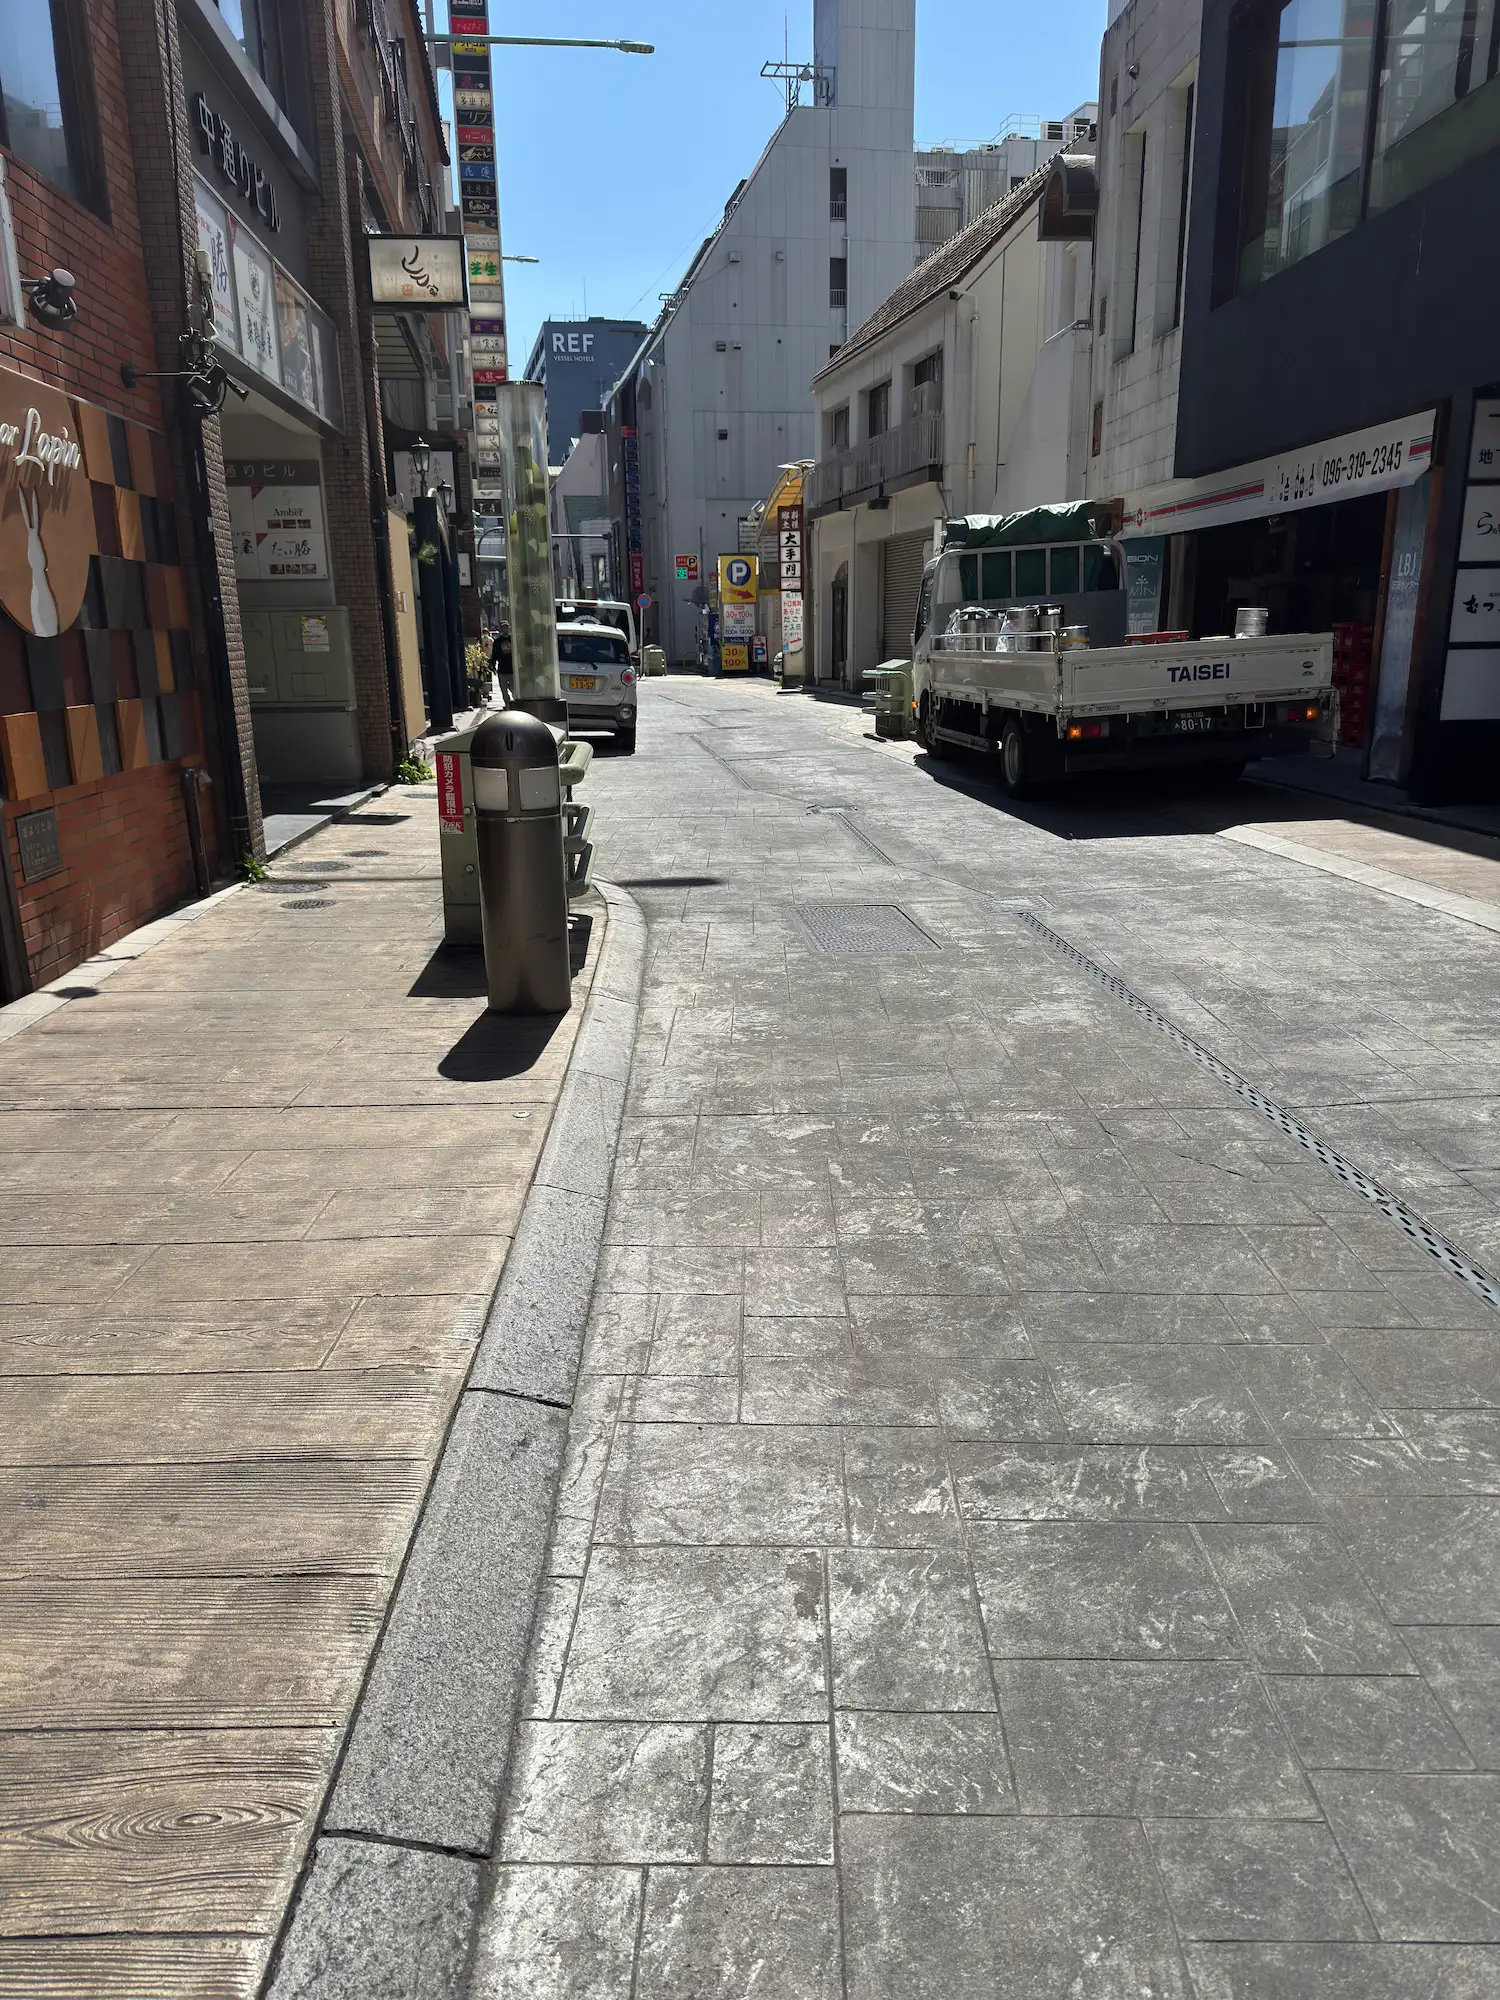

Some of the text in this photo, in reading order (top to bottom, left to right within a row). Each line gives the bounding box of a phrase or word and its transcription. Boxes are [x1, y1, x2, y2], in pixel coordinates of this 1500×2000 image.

[198, 91, 281, 234] 中通りビル
[470, 261, 497, 277] 芝生
[552, 332, 595, 353] REF
[15, 407, 81, 486] Lapin
[1322, 440, 1403, 487] 096-319-2345
[273, 507, 305, 517] Amber
[784, 532, 798, 576] 大手門
[731, 562, 748, 583] P
[754, 647, 766, 660] P
[1167, 662, 1231, 683] TAISEI
[1180, 717, 1212, 731] 80-17
[442, 754, 457, 816] 防犯カメラ監視中
